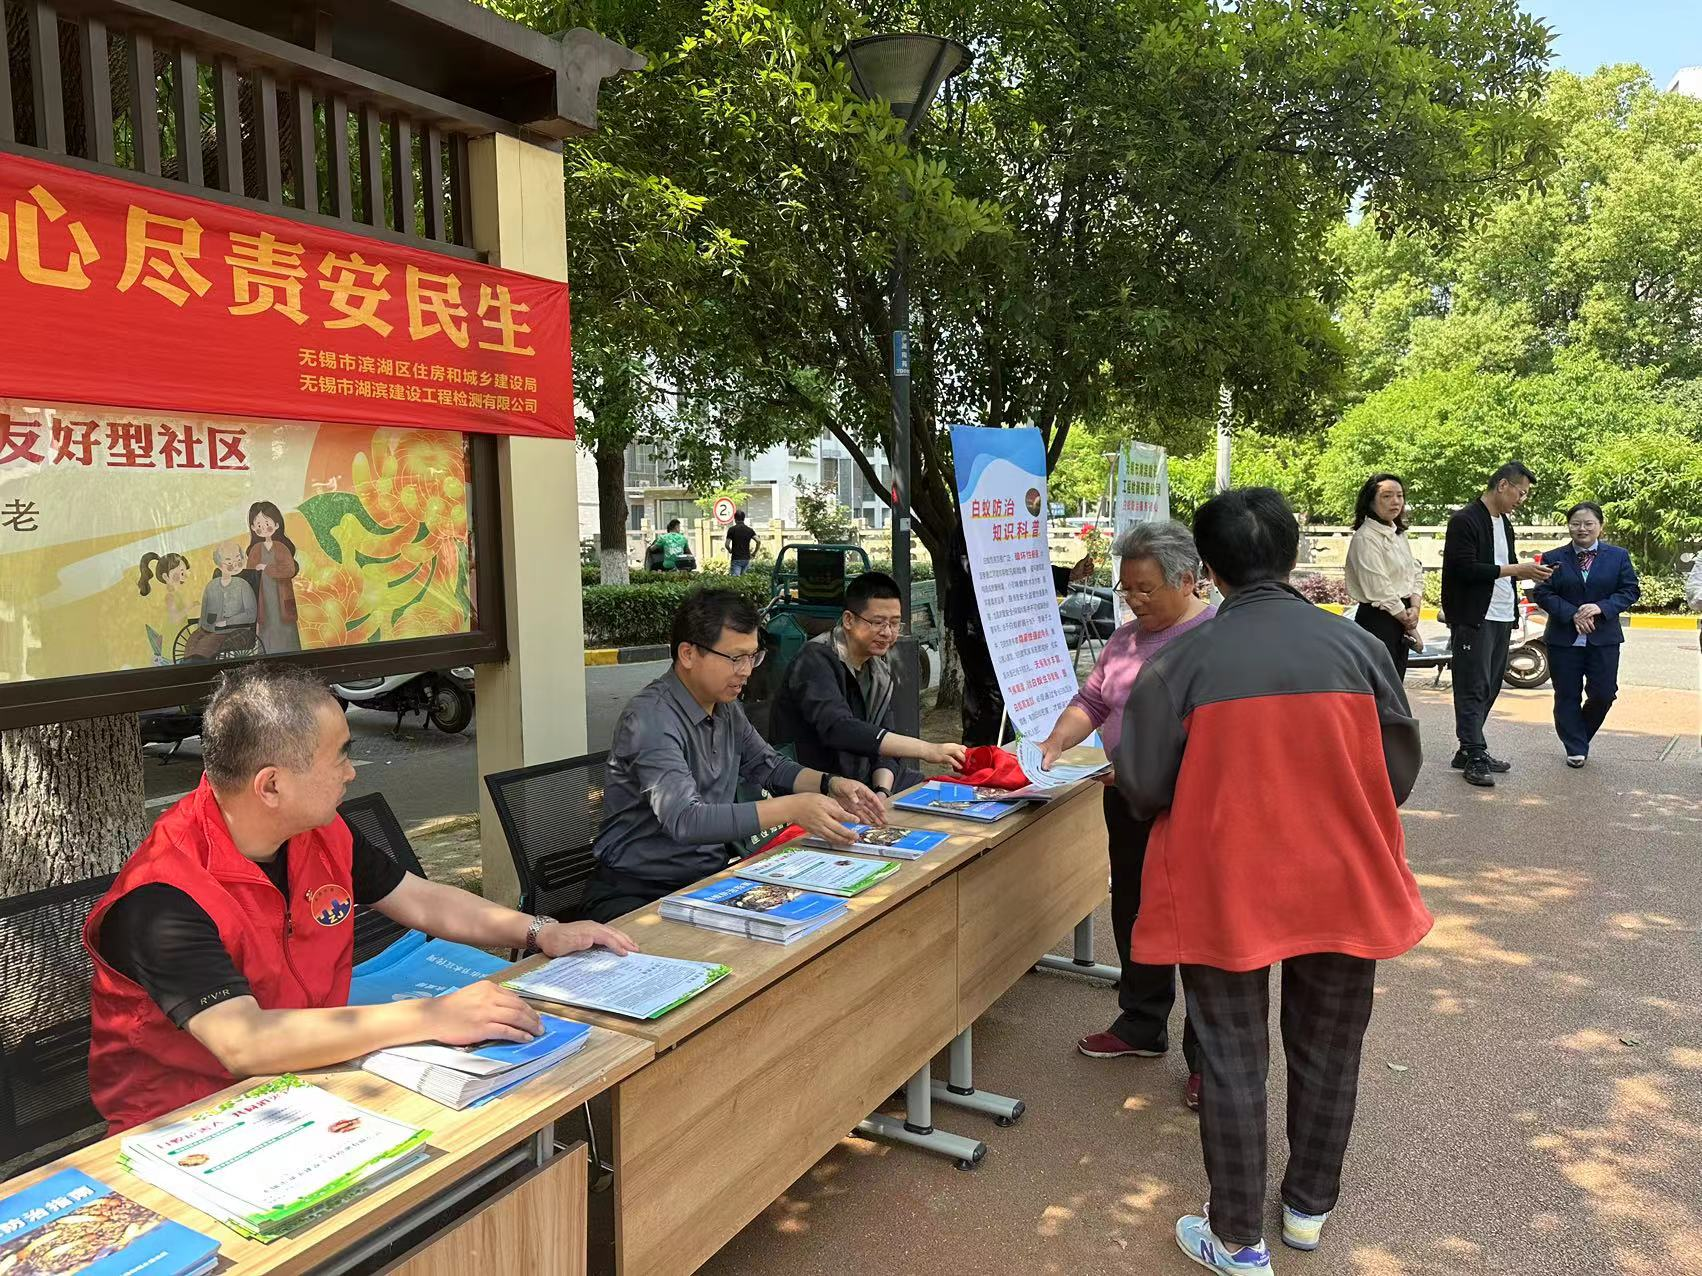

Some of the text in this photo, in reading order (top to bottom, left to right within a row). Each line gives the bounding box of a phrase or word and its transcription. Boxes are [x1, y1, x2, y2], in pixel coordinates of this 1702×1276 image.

[0, 184, 536, 356] 心尽责安民生
[298, 348, 538, 393] 无锡市滨湖区住房和城乡建设局
[299, 374, 538, 414] 无锡市湖滨建设工程检测有限公司
[0, 413, 250, 471] 友好型社区
[1, 498, 40, 532] 老
[972, 498, 1015, 518] 白蚁防治
[993, 520, 1040, 541] 知识科普
